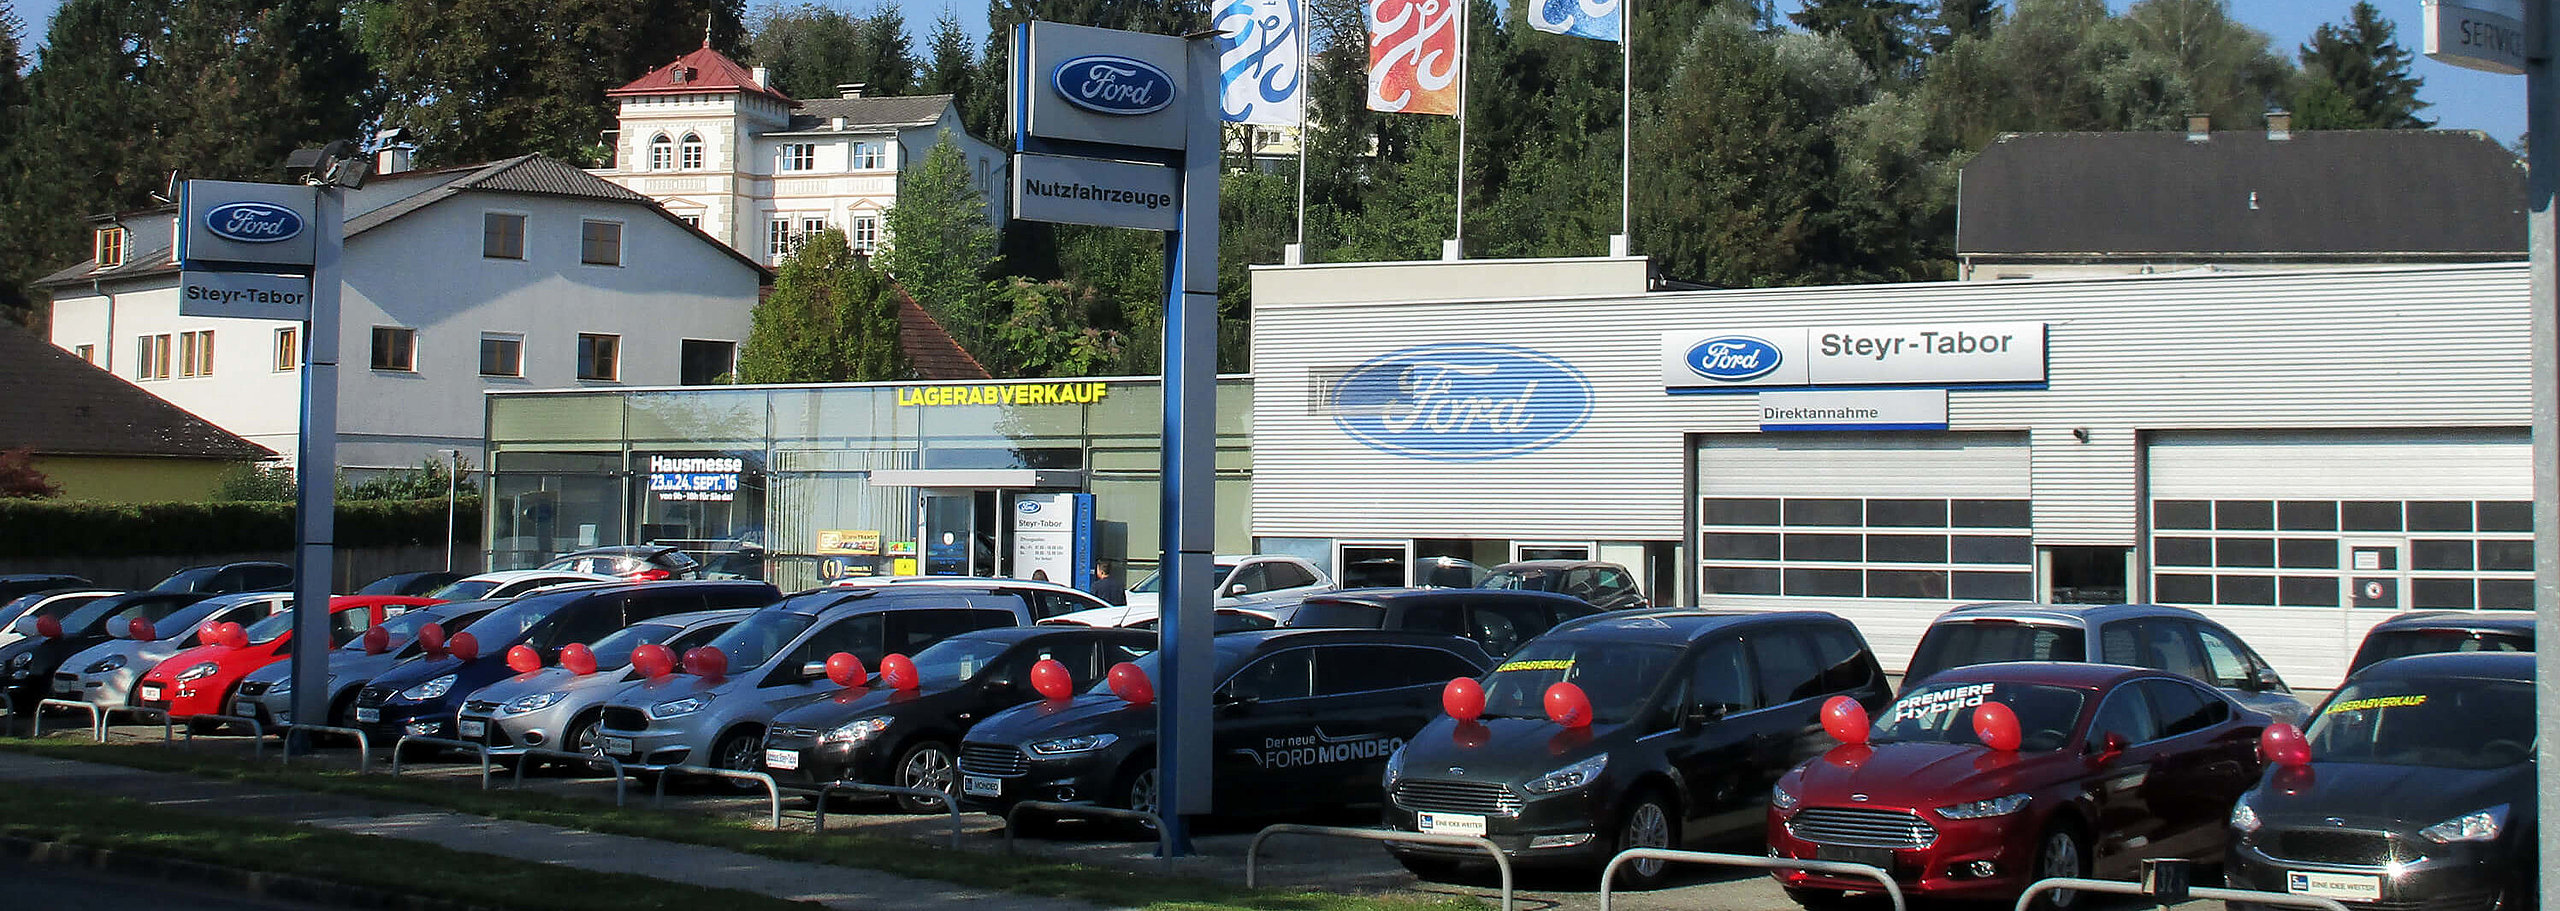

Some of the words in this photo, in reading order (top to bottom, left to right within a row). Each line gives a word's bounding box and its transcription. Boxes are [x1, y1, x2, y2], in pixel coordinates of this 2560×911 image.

[2460, 19, 2524, 57] SERVIC
[1081, 64, 1154, 105] Ford
[1026, 178, 1171, 209] Nutzfahrzeuge
[226, 208, 286, 235] Ford
[187, 286, 305, 305] Steyr-Tabor
[1701, 341, 1759, 370] Ford
[1821, 331, 2013, 361] Steyr-Tabor
[898, 383, 1107, 406] LAGERABVERKAUF
[1381, 363, 1539, 433] Ford
[1764, 406, 1878, 420] Direktannahme
[650, 455, 743, 472] Hausmesse
[1019, 520, 1062, 528] Steyr-Tabor
[1895, 694, 1984, 722] Hybrid
[1896, 683, 1995, 711] PREMIERE
[2325, 695, 2428, 714] LAGERABVERKAUF
[1265, 737, 1285, 749] Der
[1288, 735, 1316, 746] neue
[1266, 748, 1316, 768] FORD
